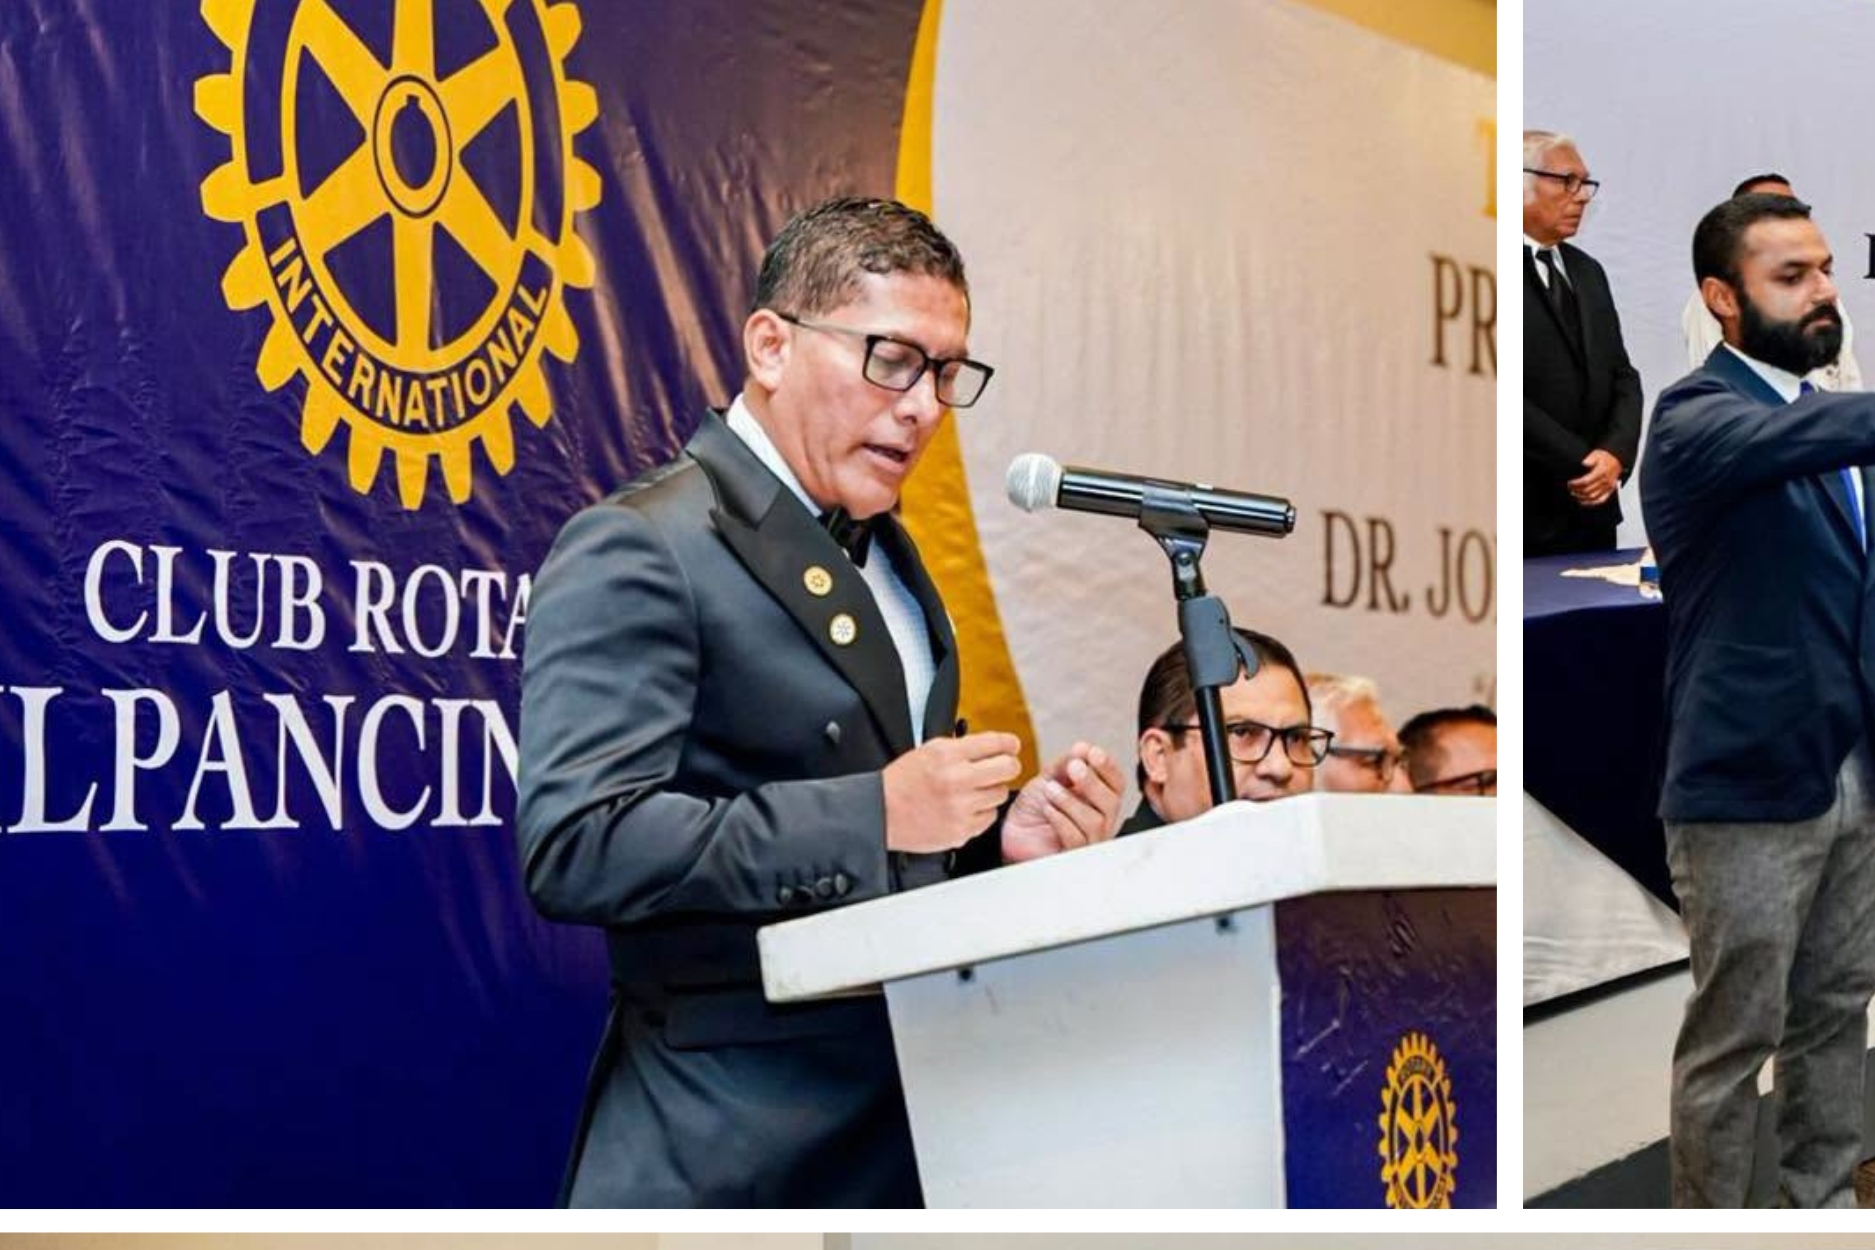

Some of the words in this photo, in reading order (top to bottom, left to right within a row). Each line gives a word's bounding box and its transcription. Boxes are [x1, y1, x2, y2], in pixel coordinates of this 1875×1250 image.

[269, 236, 548, 430] INTERNATIONAL
[84, 540, 326, 651] CLUB
[1321, 509, 1411, 614] DR.
[1426, 526, 1497, 625] JO
